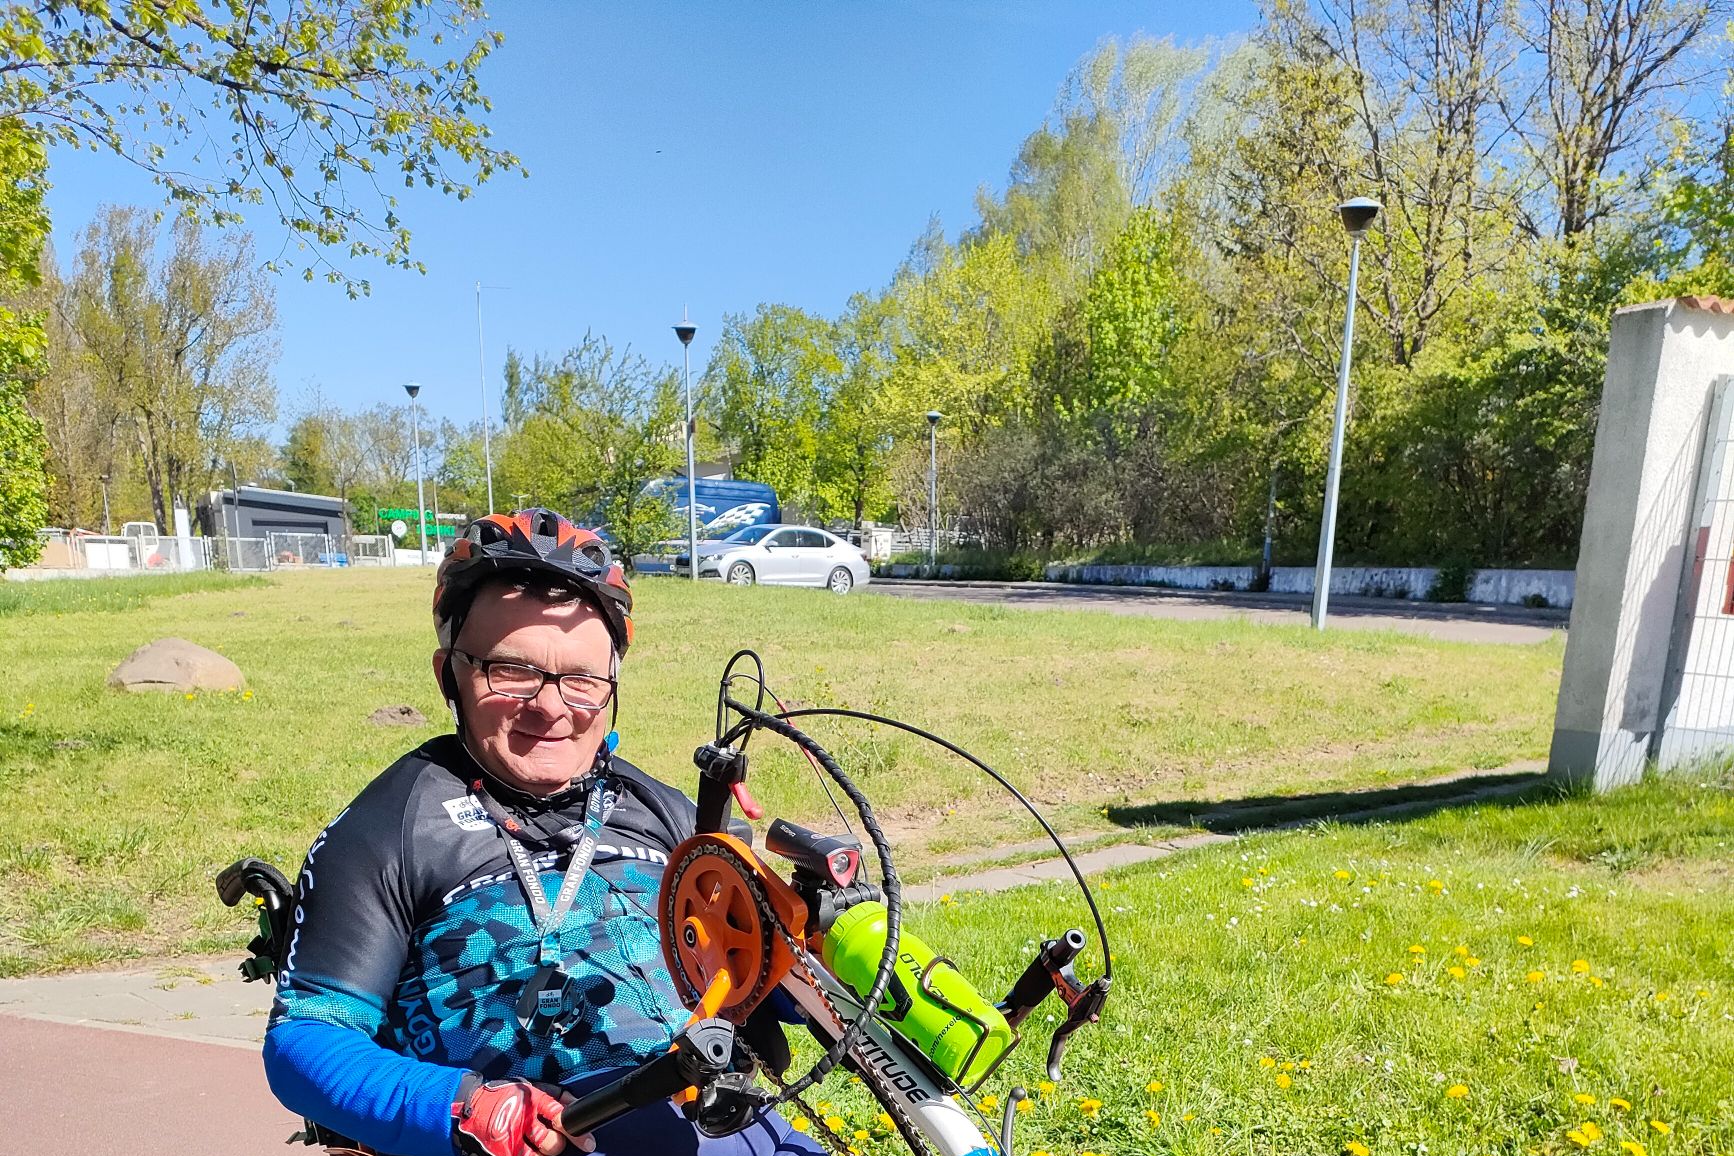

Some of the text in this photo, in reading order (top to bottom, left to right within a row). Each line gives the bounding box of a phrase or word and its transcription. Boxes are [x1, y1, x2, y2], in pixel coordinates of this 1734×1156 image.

[378, 507, 434, 520] CAMPIG
[510, 839, 546, 905] GRAN FONDO
[560, 862, 581, 902] GRAN
[573, 836, 595, 868] FONDO
